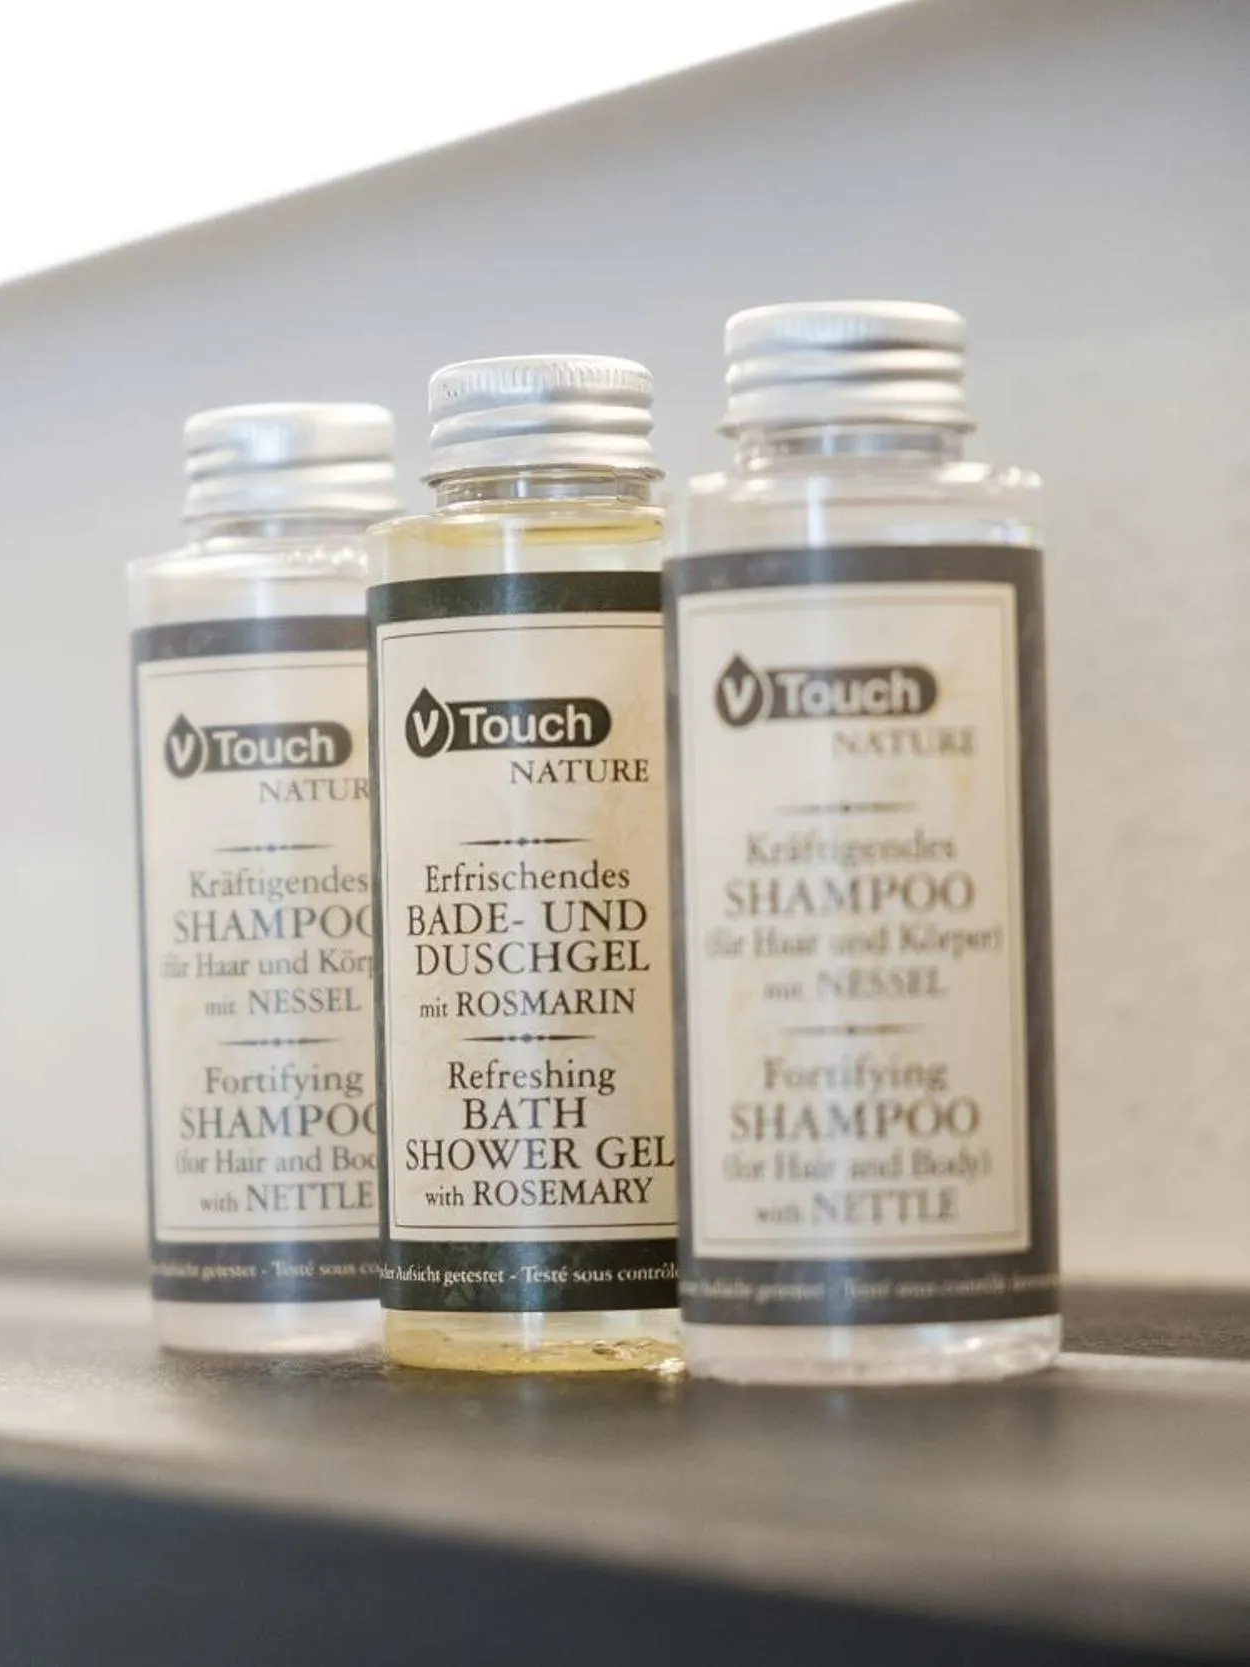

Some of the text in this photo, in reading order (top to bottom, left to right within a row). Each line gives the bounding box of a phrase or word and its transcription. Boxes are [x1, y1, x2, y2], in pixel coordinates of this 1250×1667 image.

[775, 667, 922, 717] Touch
[459, 704, 593, 745] Touch
[832, 725, 977, 758] NATURE
[212, 726, 336, 767] Touch
[509, 758, 650, 785] NATURE
[258, 776, 371, 804] NATUR
[188, 864, 369, 902] Kräftigendes
[424, 859, 631, 894] Erfrischendes
[724, 870, 977, 919] SHAMPOO
[407, 898, 649, 937] BADE- UND
[415, 939, 651, 976] DUSCHGEL
[752, 926, 820, 957] Haar
[830, 923, 890, 956] und
[196, 951, 250, 978] Haar
[258, 949, 309, 976] und
[816, 966, 948, 998] NESSEL
[205, 987, 362, 1016] mit NESSEL
[419, 988, 636, 1018] mit ROSMARIN
[204, 1063, 365, 1100] Fortifying
[447, 1058, 617, 1097] Refreshing
[763, 1053, 949, 1094] Fortifying
[462, 1096, 588, 1131] BATH
[729, 1095, 983, 1143] SHAMPOO
[214, 1147, 267, 1175] Hair
[275, 1145, 323, 1173] and
[406, 1135, 676, 1172] SHOWER GEL
[773, 1149, 837, 1181] Hair
[850, 1147, 903, 1179] and
[911, 1146, 993, 1186] Body)
[200, 1180, 375, 1214] with NETTLE
[425, 1177, 653, 1208] with ROSEMARY
[811, 1186, 958, 1226] NETTLE
[443, 1267, 504, 1286] getestet
[521, 1264, 568, 1284] Testé
[572, 1267, 613, 1283] sous
